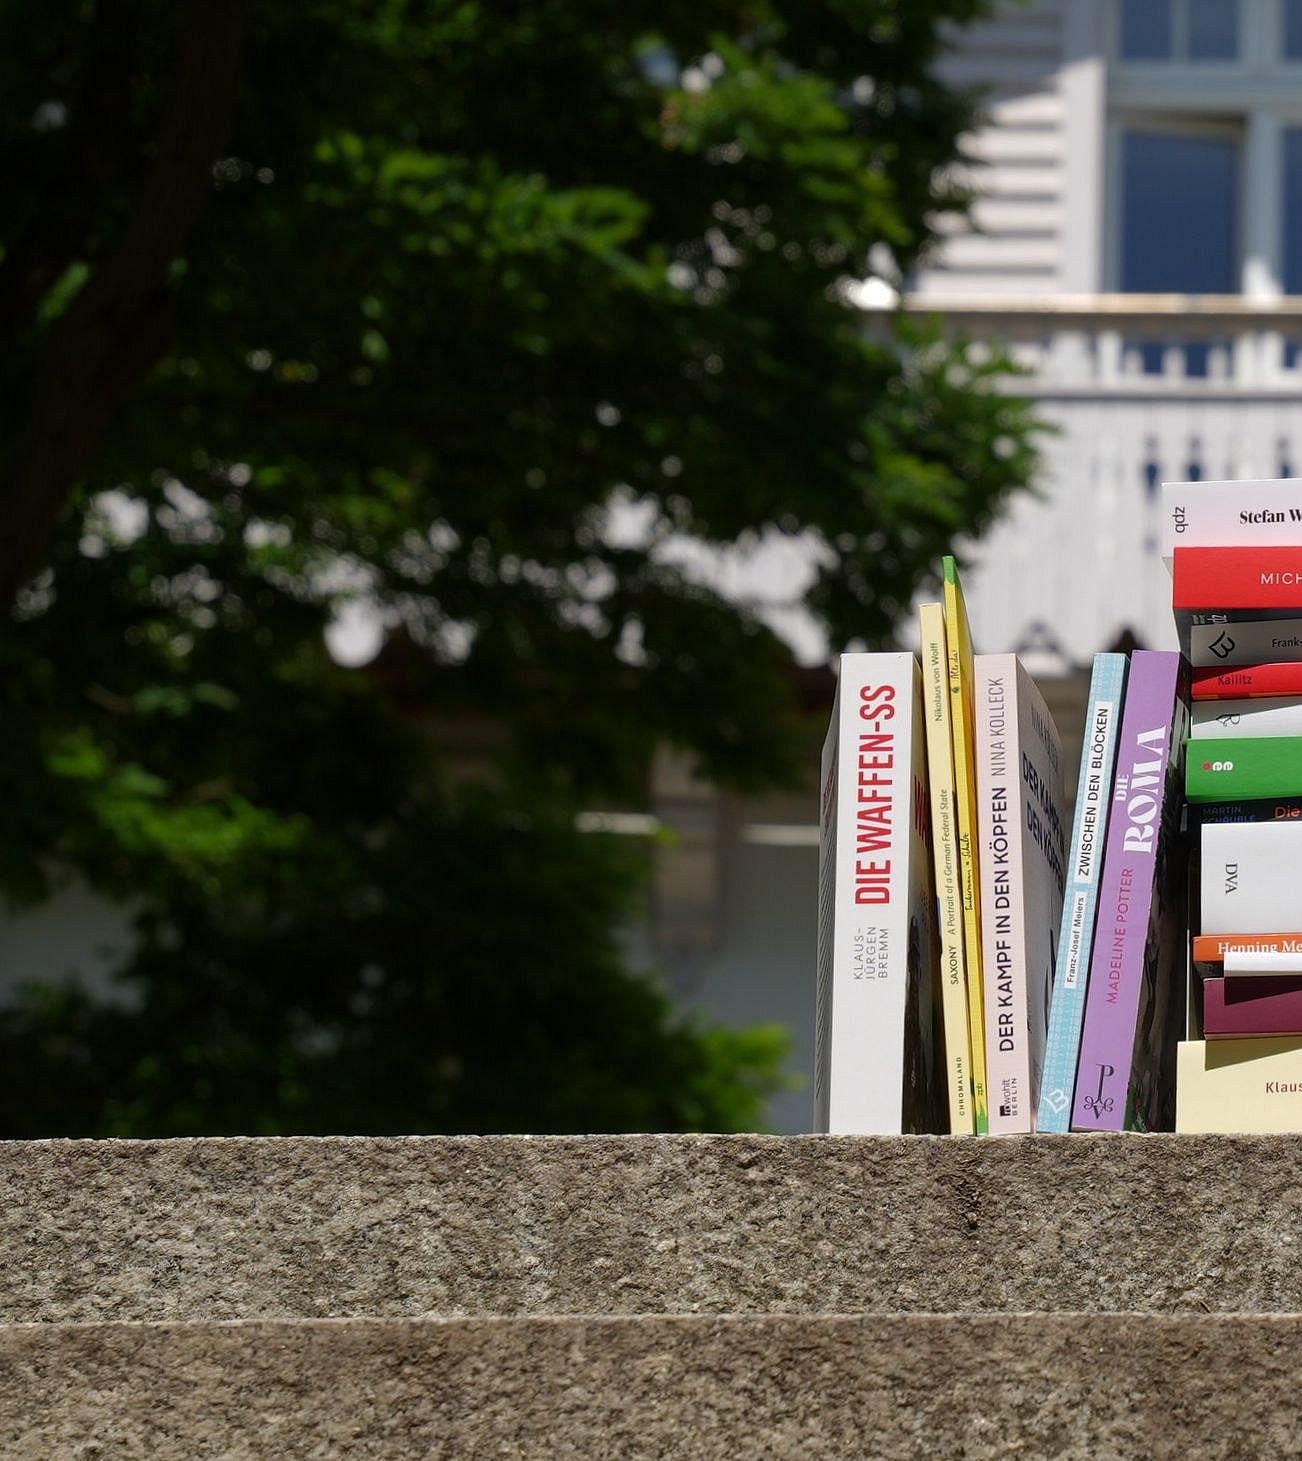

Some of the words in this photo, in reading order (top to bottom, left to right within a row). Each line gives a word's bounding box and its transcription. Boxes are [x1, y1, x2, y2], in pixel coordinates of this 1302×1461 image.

[1239, 508, 1286, 525] Stefan
[1216, 672, 1253, 687] Kailitz
[934, 684, 942, 722] Nikolaus
[988, 677, 1005, 738] KOLLECK
[990, 741, 1006, 776] NINA
[1090, 708, 1109, 769] BLÖCKEN
[856, 684, 896, 854] WAFFEN-SS
[1088, 774, 1100, 801] DEN
[1115, 773, 1130, 802] DIE
[940, 788, 948, 809] State
[1123, 725, 1166, 854] ROMA
[989, 787, 1010, 865] KÖPFEN
[1274, 806, 1300, 820] Die
[1078, 806, 1097, 876] ZWISCHEN
[854, 860, 891, 905] DIE
[947, 882, 955, 894] of
[994, 870, 1010, 909] DEN
[1224, 862, 1239, 895] DVA
[947, 897, 955, 928] Portrait
[996, 914, 1010, 934] IN
[1073, 896, 1084, 928] Meiers
[853, 927, 864, 980] KLAUS-
[863, 926, 877, 980] JÜRGEN
[878, 928, 889, 979] BREMM
[1105, 928, 1126, 1004] MADELINE
[1117, 868, 1134, 922] POTTER
[1217, 941, 1278, 954] Henning
[949, 945, 959, 985] SAXONY
[997, 940, 1013, 1010] KAMPF
[1067, 930, 1080, 984] Franz-Josef
[999, 1012, 1014, 1052] DER
[956, 1056, 965, 1117] CHROMALAND
